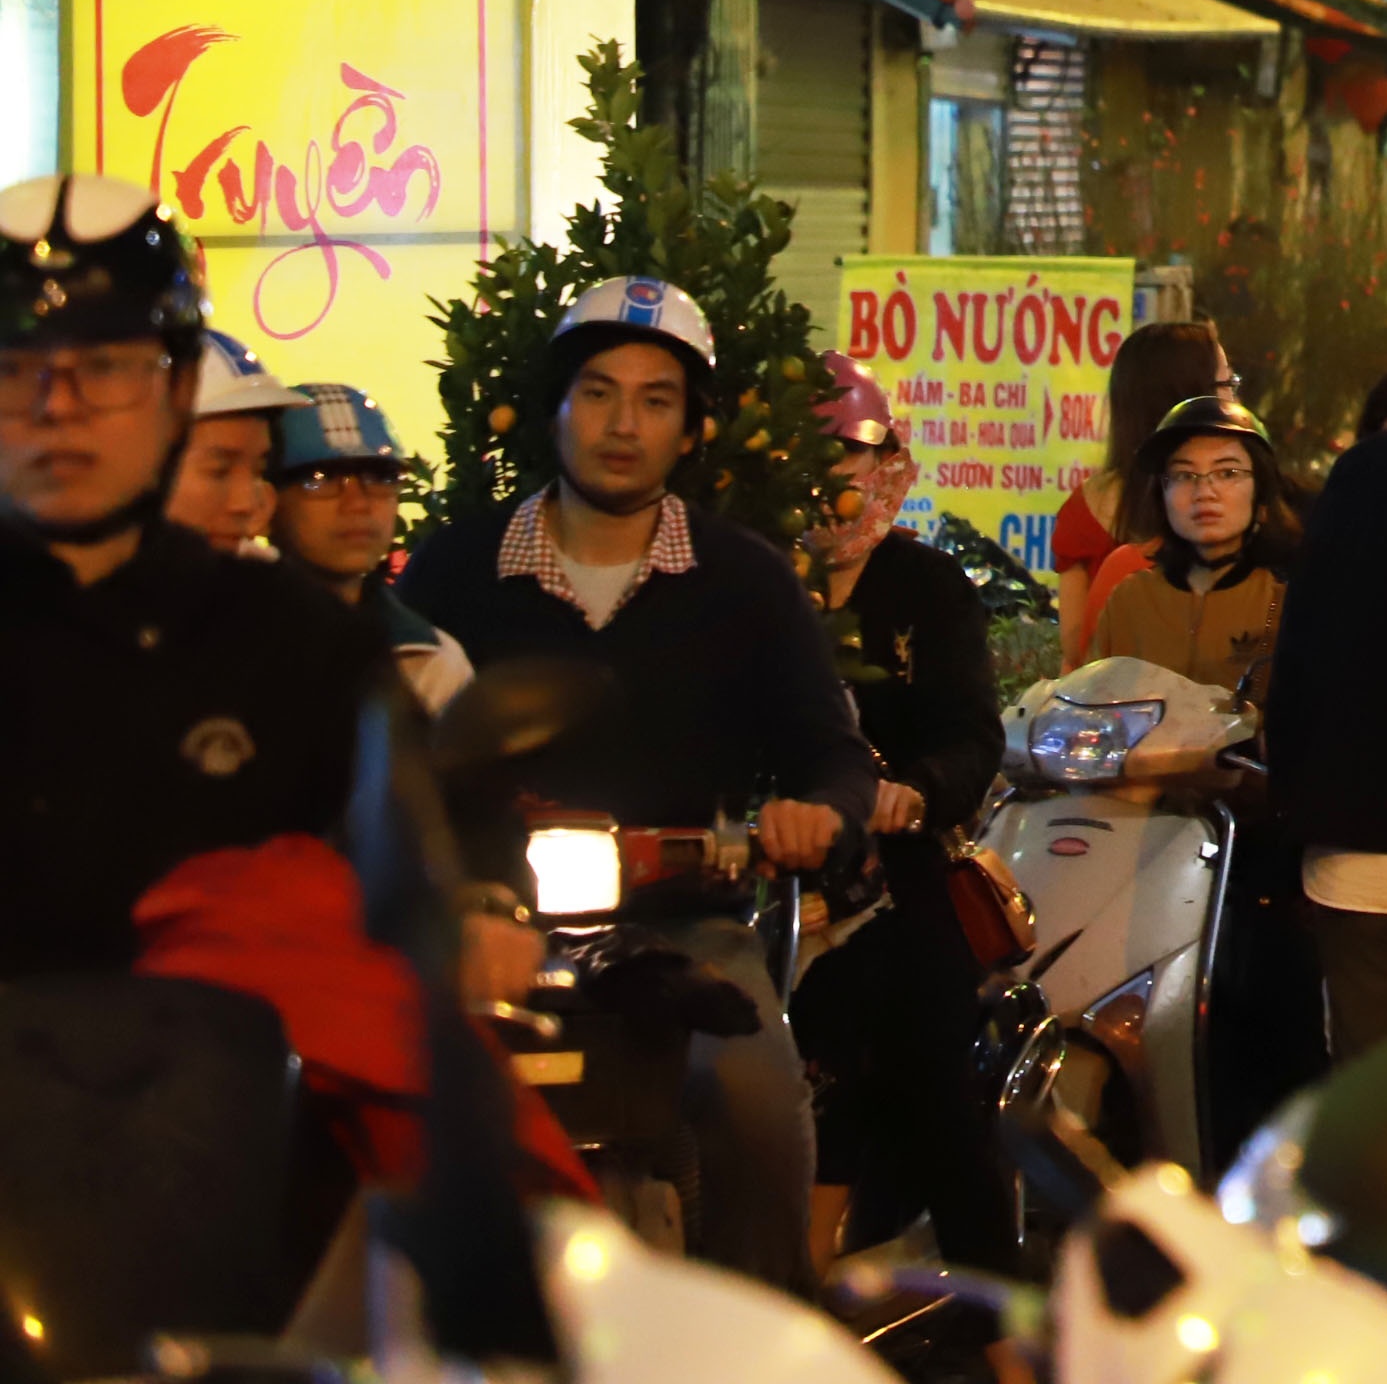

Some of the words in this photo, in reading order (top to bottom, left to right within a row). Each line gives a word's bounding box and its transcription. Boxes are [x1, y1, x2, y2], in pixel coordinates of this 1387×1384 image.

[121, 24, 440, 339] Truyền
[848, 272, 917, 362] BÒ
[931, 274, 1123, 367] NƯỚNG
[959, 382, 986, 408] BA
